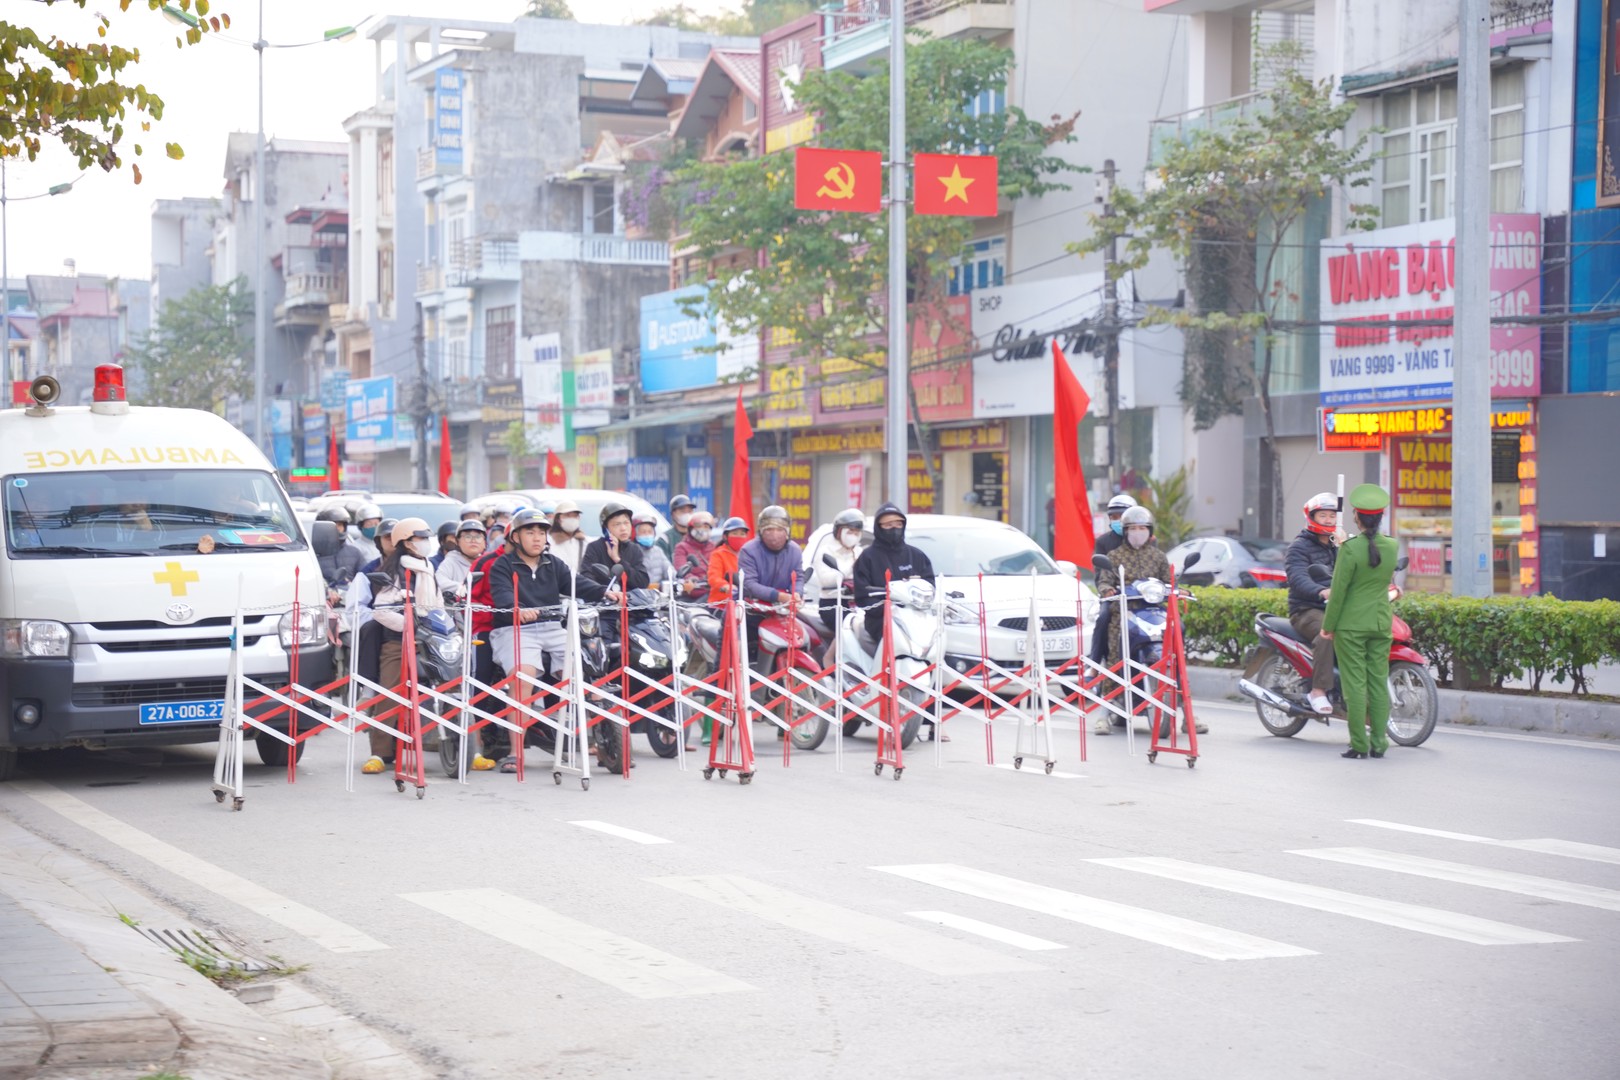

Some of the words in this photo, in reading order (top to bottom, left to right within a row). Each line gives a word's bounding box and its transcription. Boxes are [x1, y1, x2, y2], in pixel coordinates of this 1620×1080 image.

[1490, 224, 1537, 269] ÀNG
[1328, 243, 1400, 305] VÀNG
[979, 296, 1002, 312] SHOP
[1330, 355, 1361, 377] VÀNG
[1365, 355, 1394, 375] 9999
[1405, 347, 1439, 371] VÀNG
[148, 703, 225, 721] 27A-006.27
